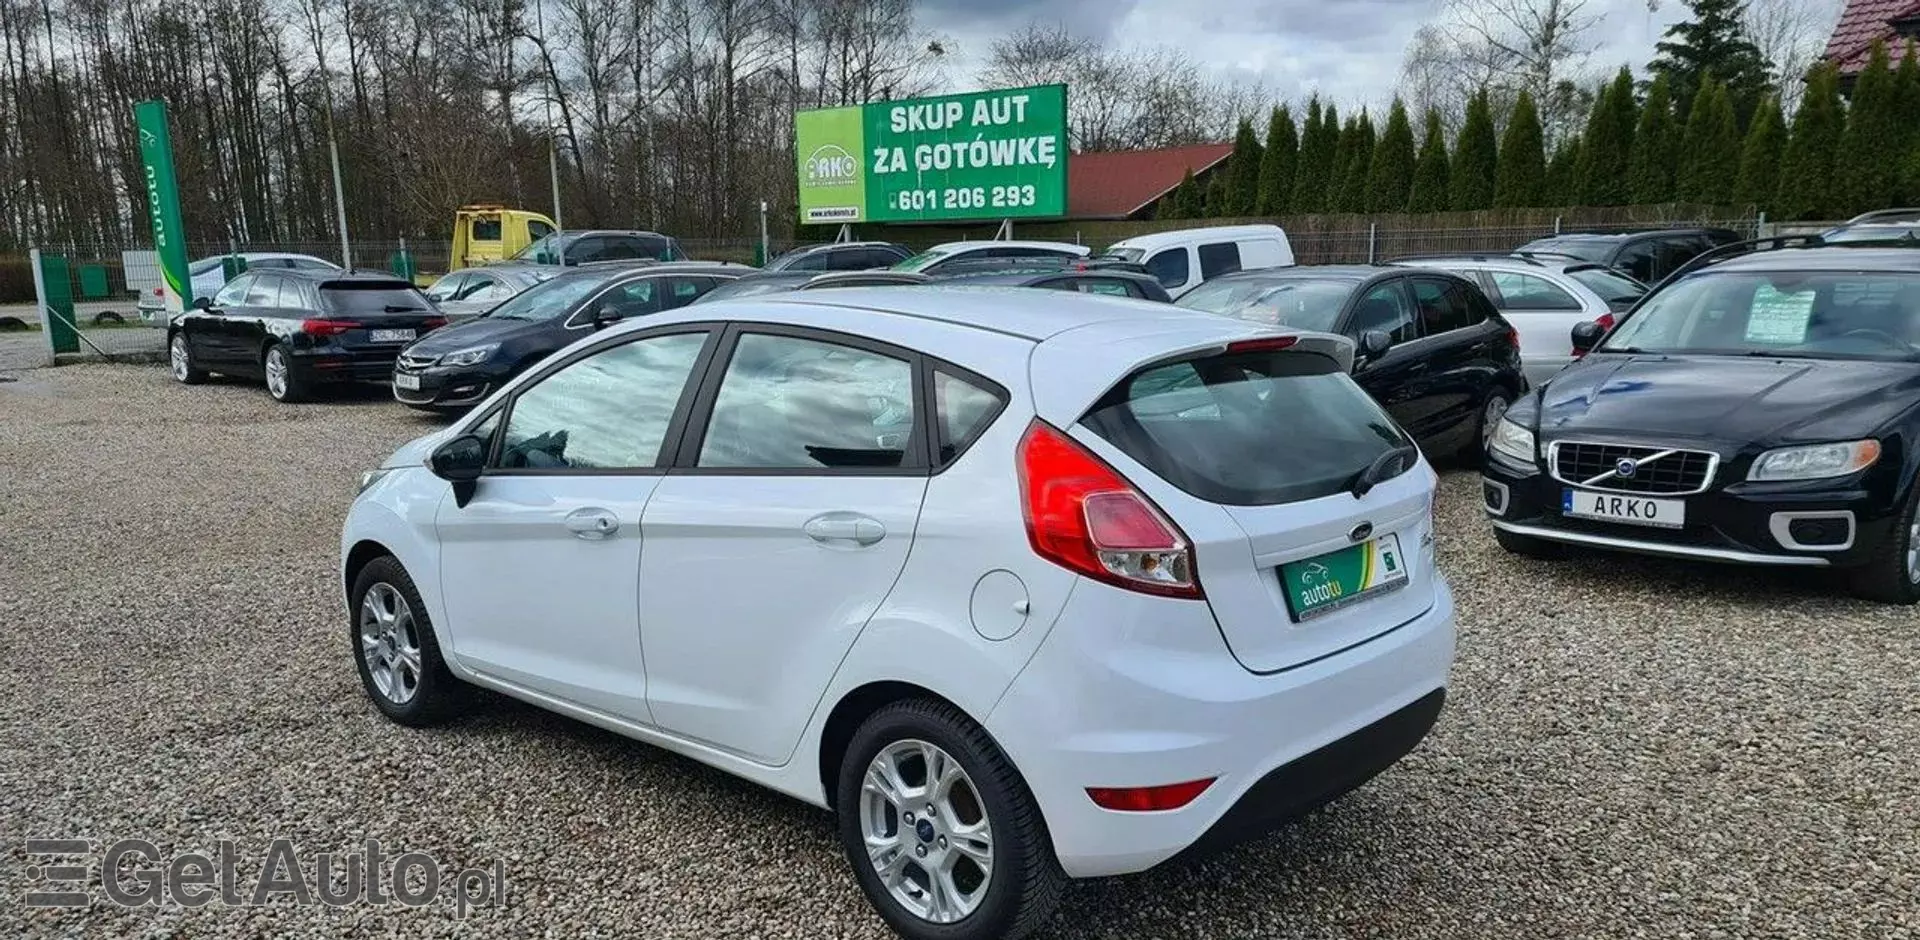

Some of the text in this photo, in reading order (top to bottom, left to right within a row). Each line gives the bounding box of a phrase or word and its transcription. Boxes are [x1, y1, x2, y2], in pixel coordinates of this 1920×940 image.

[890, 95, 1029, 133] SKUP AUT
[873, 133, 1056, 173] ZA GOTÓWKĘ
[146, 165, 166, 247] autotu
[898, 184, 1035, 210] 601 206 293
[1594, 496, 1657, 519] ARKO
[1301, 580, 1343, 606] autotu
